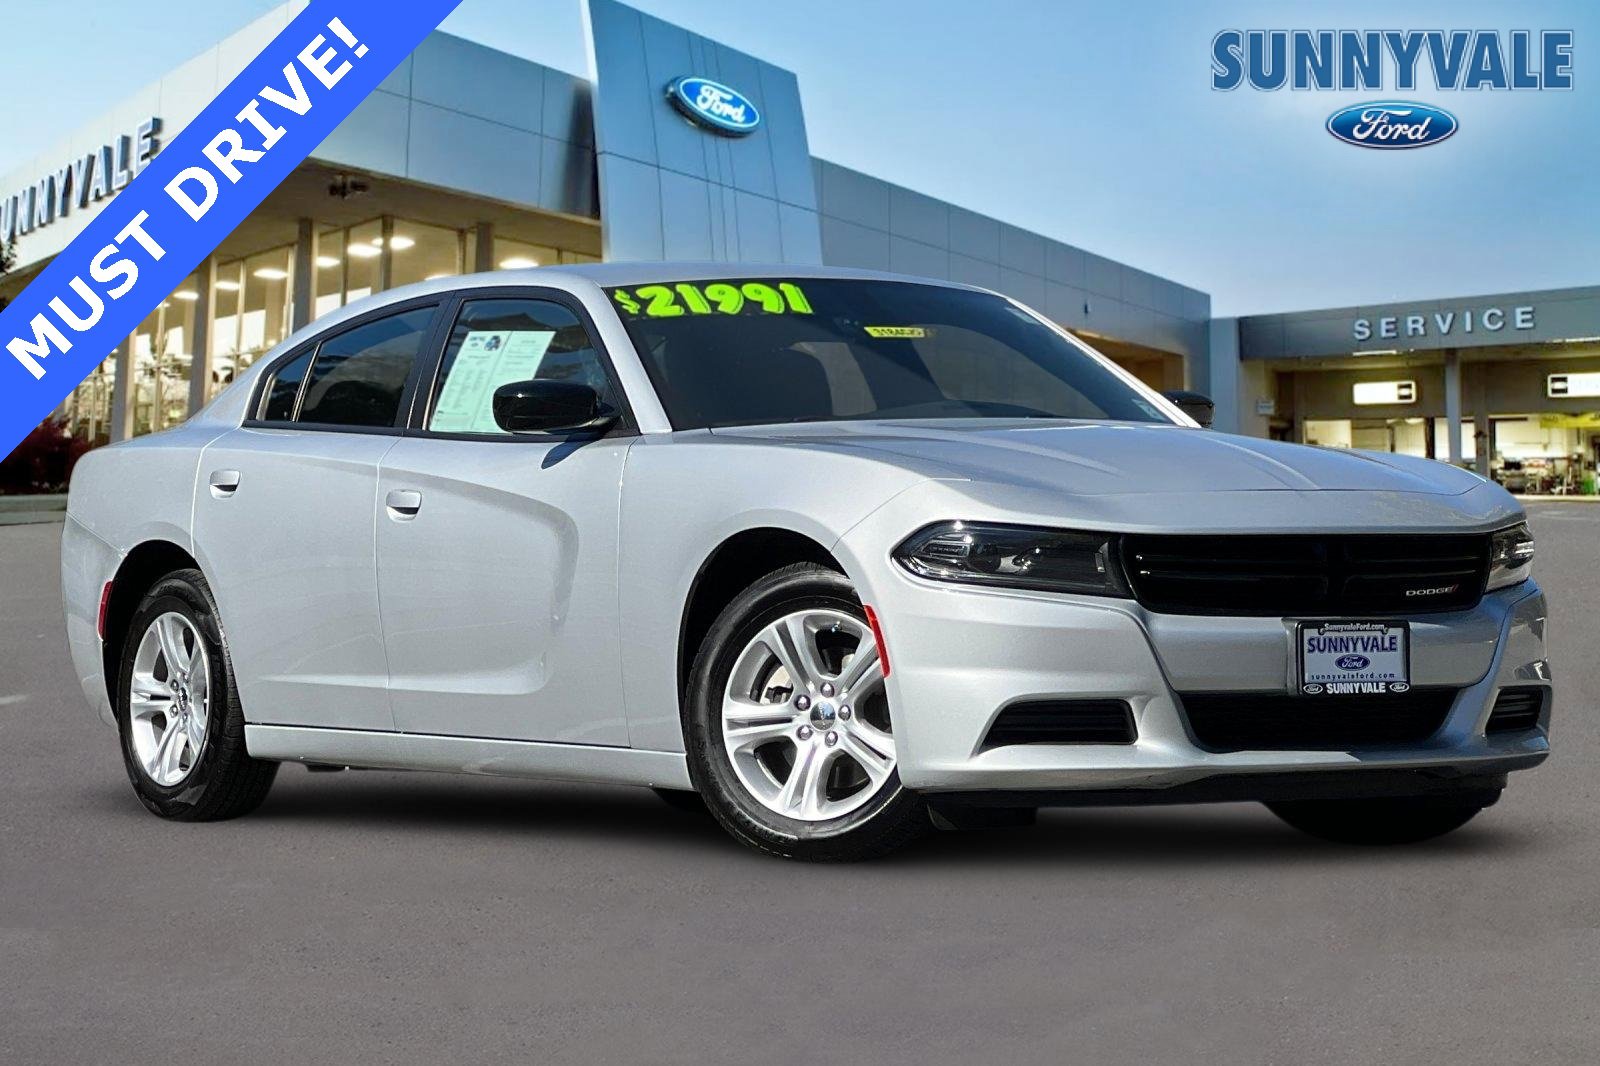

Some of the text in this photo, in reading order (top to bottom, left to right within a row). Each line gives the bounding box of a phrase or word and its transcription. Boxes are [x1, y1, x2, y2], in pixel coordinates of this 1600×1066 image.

[696, 85, 746, 123] Ford
[614, 283, 814, 317] $21991
[1353, 306, 1536, 341] SERVICE
[1406, 586, 1453, 596] DODGE
[1307, 635, 1397, 653] SUNNYVALE
[1341, 656, 1363, 669] Ford
[1311, 672, 1395, 680] sunnyvaleford.com
[1326, 682, 1386, 694] SUNNYVALE
